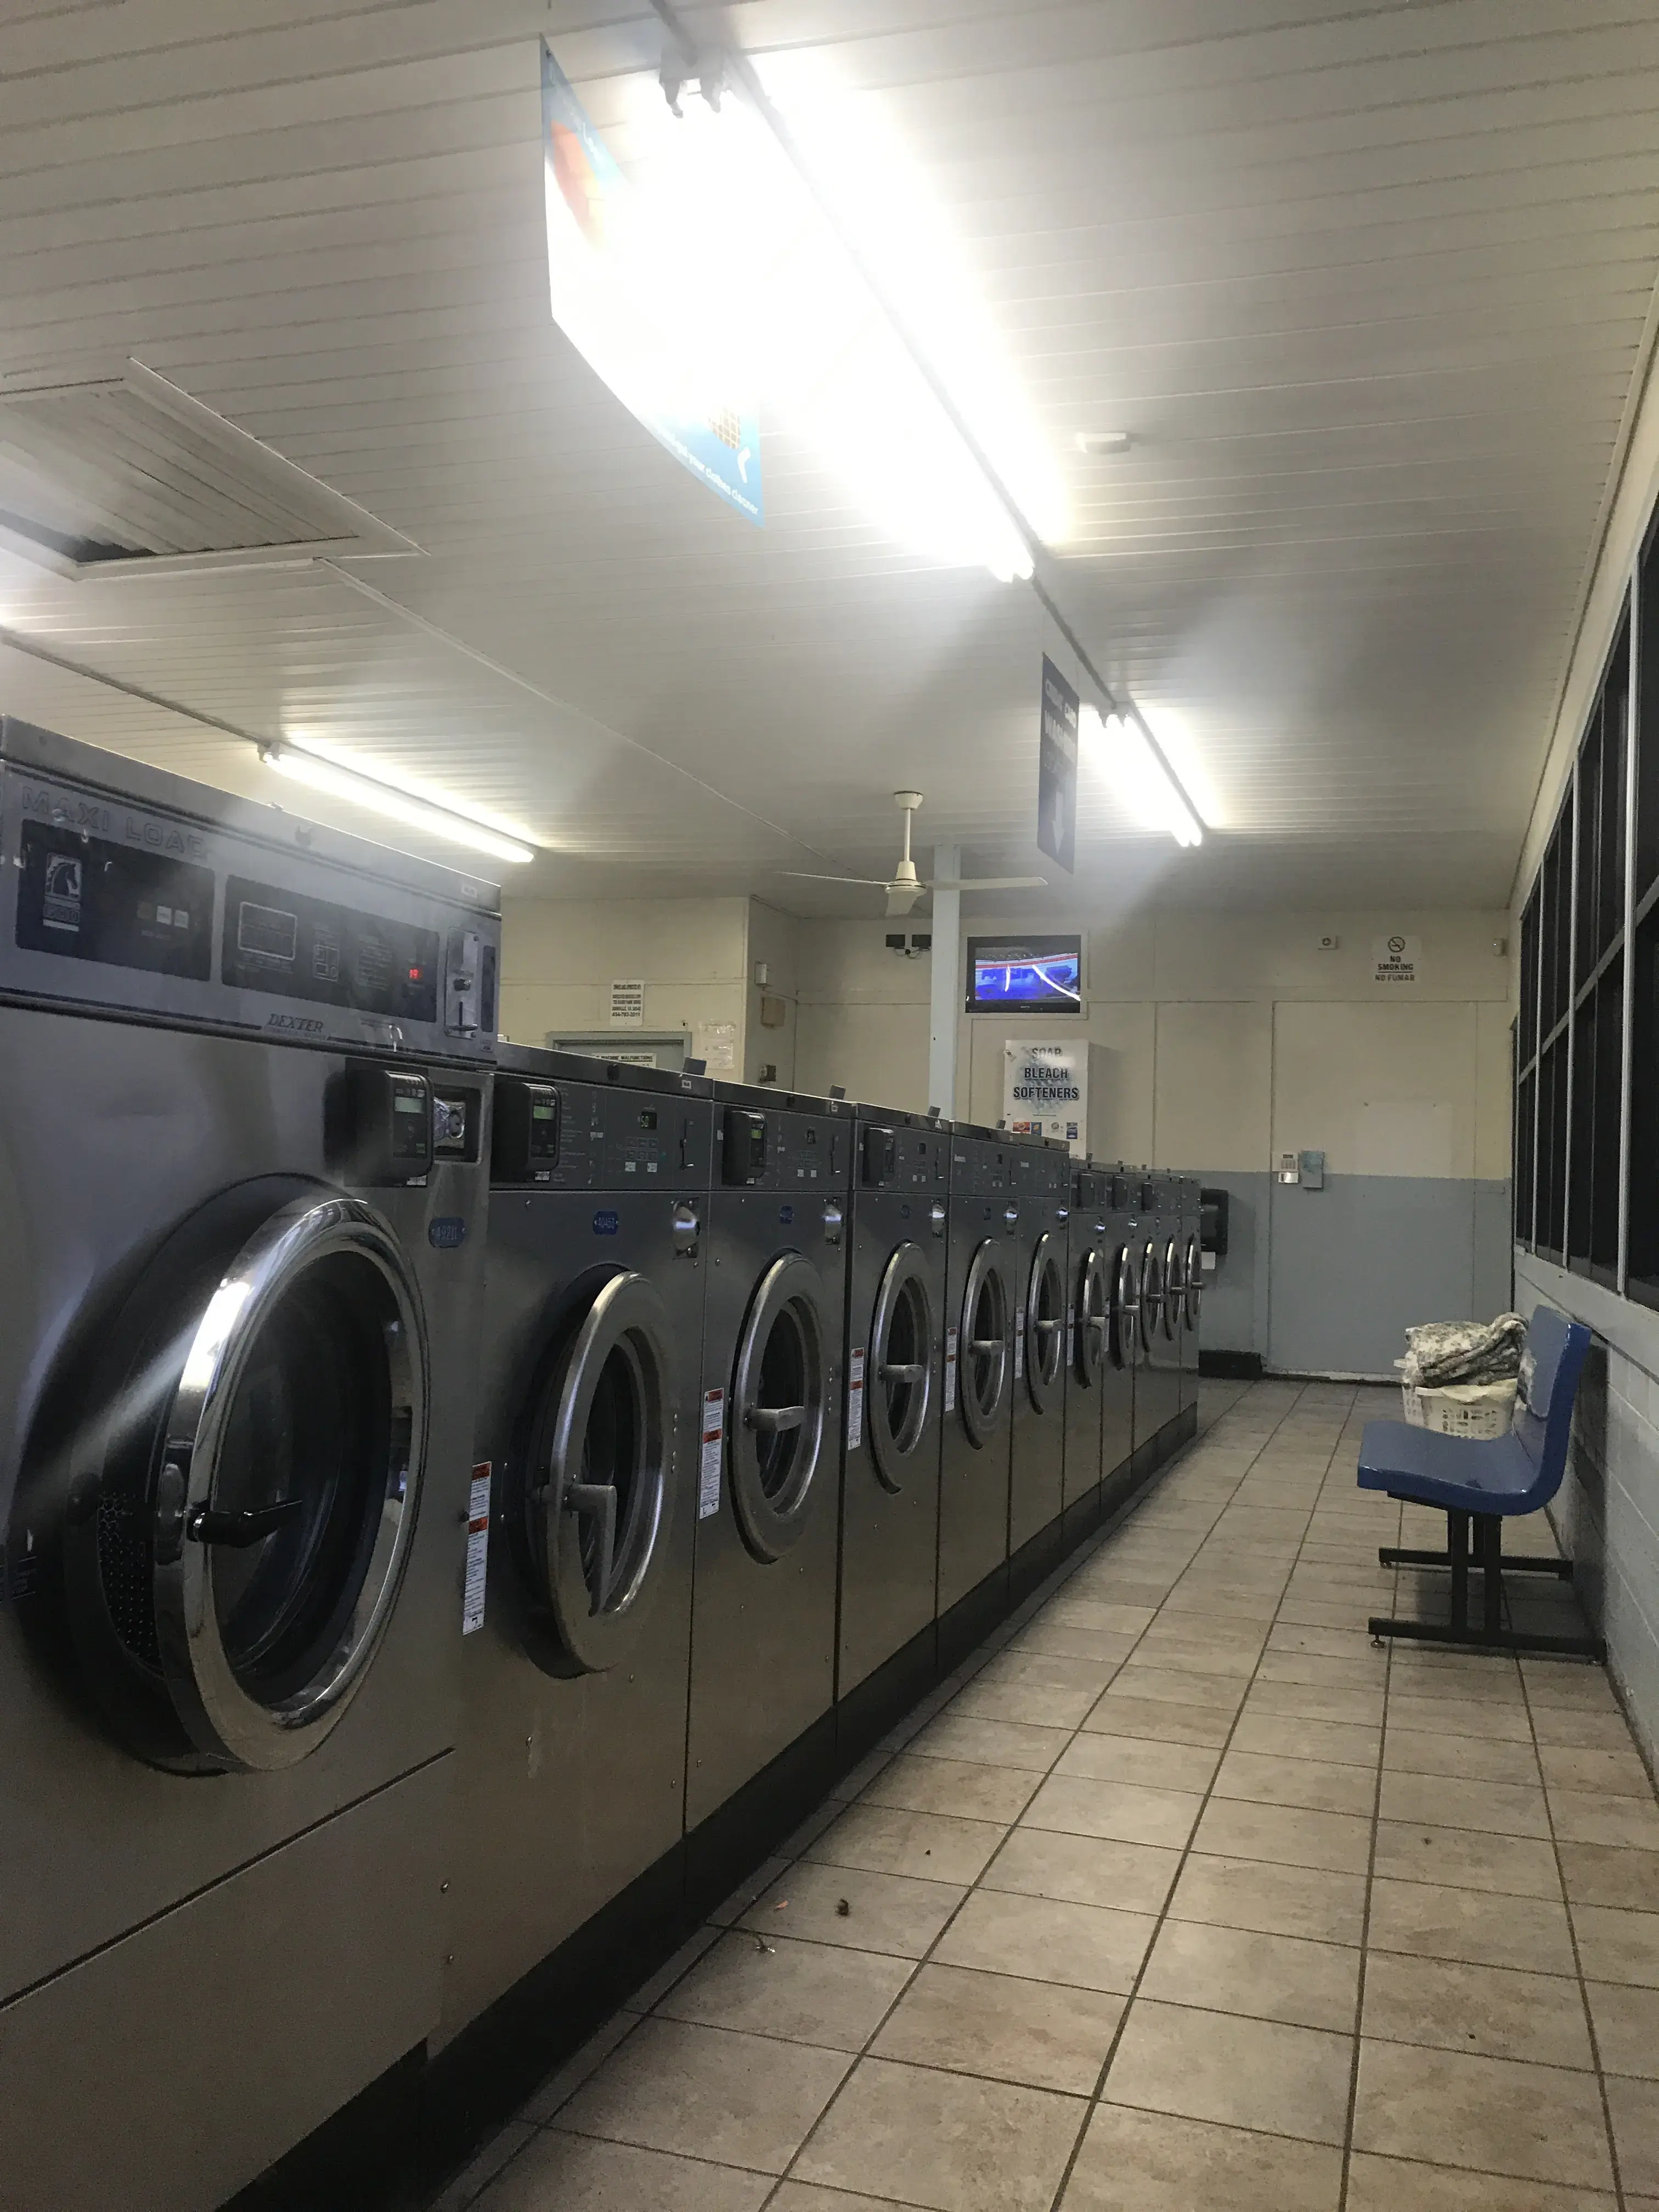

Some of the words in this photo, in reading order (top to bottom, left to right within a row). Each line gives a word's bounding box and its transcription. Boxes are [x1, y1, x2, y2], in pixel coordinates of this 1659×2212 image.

[706, 467, 731, 495] clothes
[732, 488, 758, 515] cleaner
[22, 786, 110, 832] MAXI
[267, 1013, 324, 1032] DEXTER
[1032, 1047, 1063, 1059] SOAP
[1024, 1067, 1069, 1080] BLEACH
[1013, 1086, 1080, 1099] SOFTENERS
